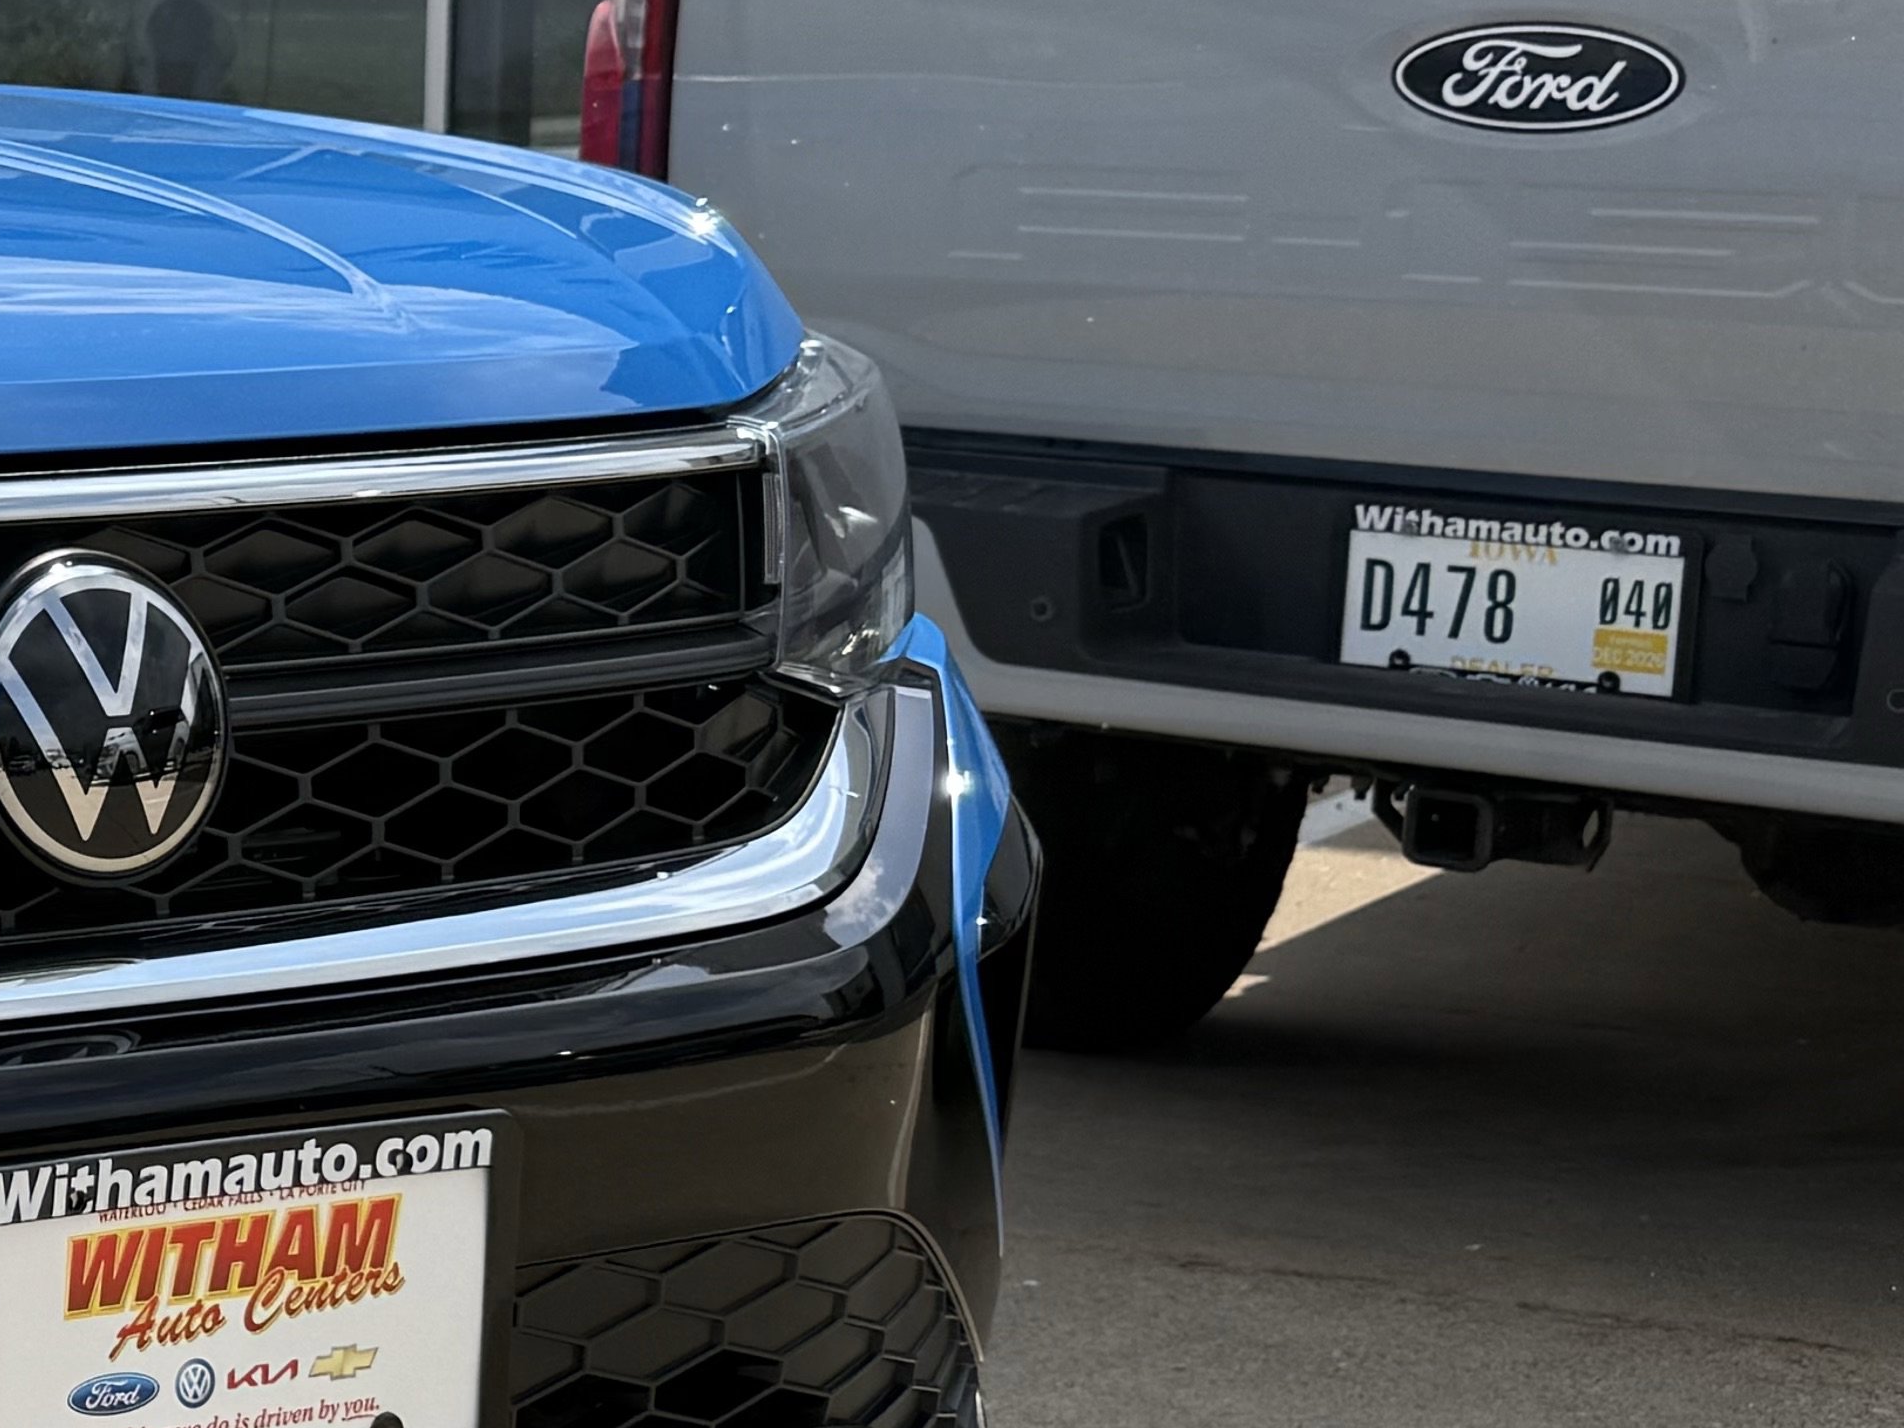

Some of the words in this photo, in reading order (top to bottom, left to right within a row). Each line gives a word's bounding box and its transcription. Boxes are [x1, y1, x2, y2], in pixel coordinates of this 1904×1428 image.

[1441, 38, 1628, 112] Ford
[1354, 503, 1681, 556] Withamauto.com
[1360, 557, 1517, 645] D478
[1598, 576, 1674, 631] 040
[227, 1191, 264, 1208] FALLS
[64, 1192, 404, 1322] WITHAM
[108, 1292, 226, 1362] Auto
[243, 1259, 408, 1336] Centers
[317, 1398, 341, 1423] by
[342, 1395, 381, 1420] you.
